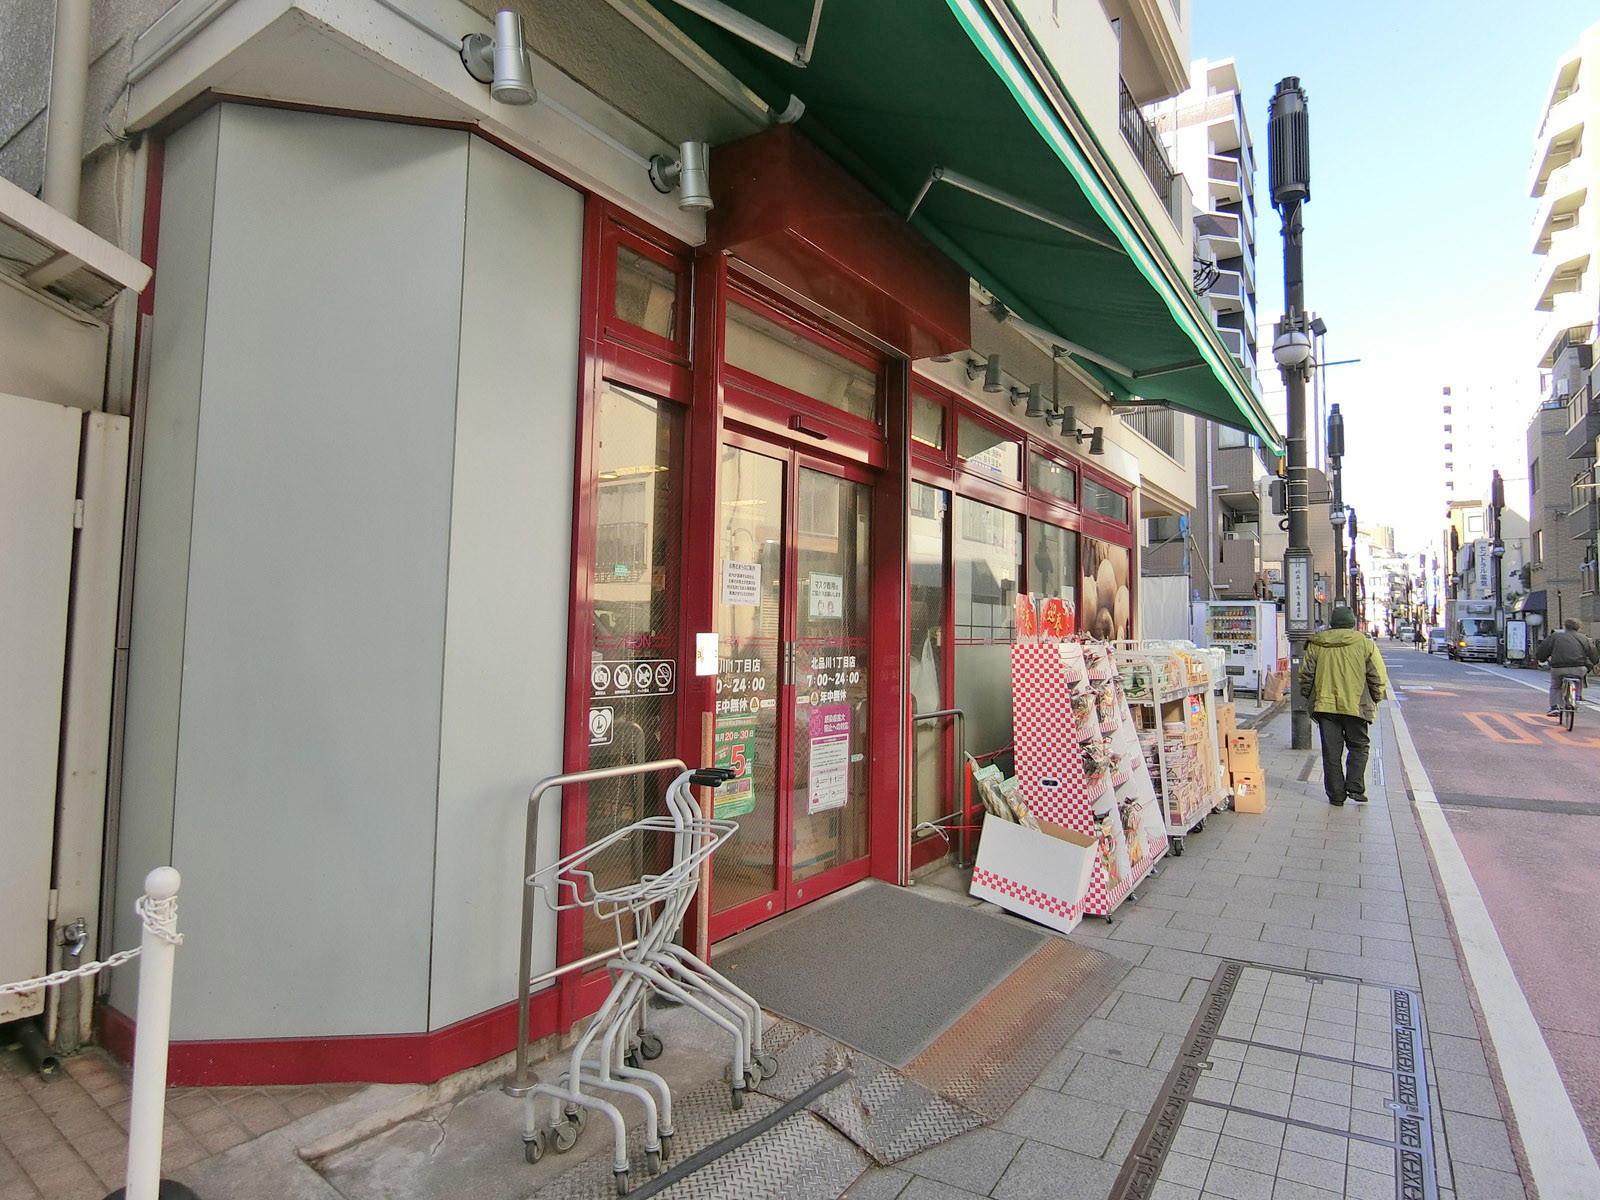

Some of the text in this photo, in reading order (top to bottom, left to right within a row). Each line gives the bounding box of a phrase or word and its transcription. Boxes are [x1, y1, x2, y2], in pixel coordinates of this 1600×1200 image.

[811, 656, 856, 670] 北品川1丁目店
[820, 689, 847, 703] 年中無休
[716, 697, 749, 714] 年中無休
